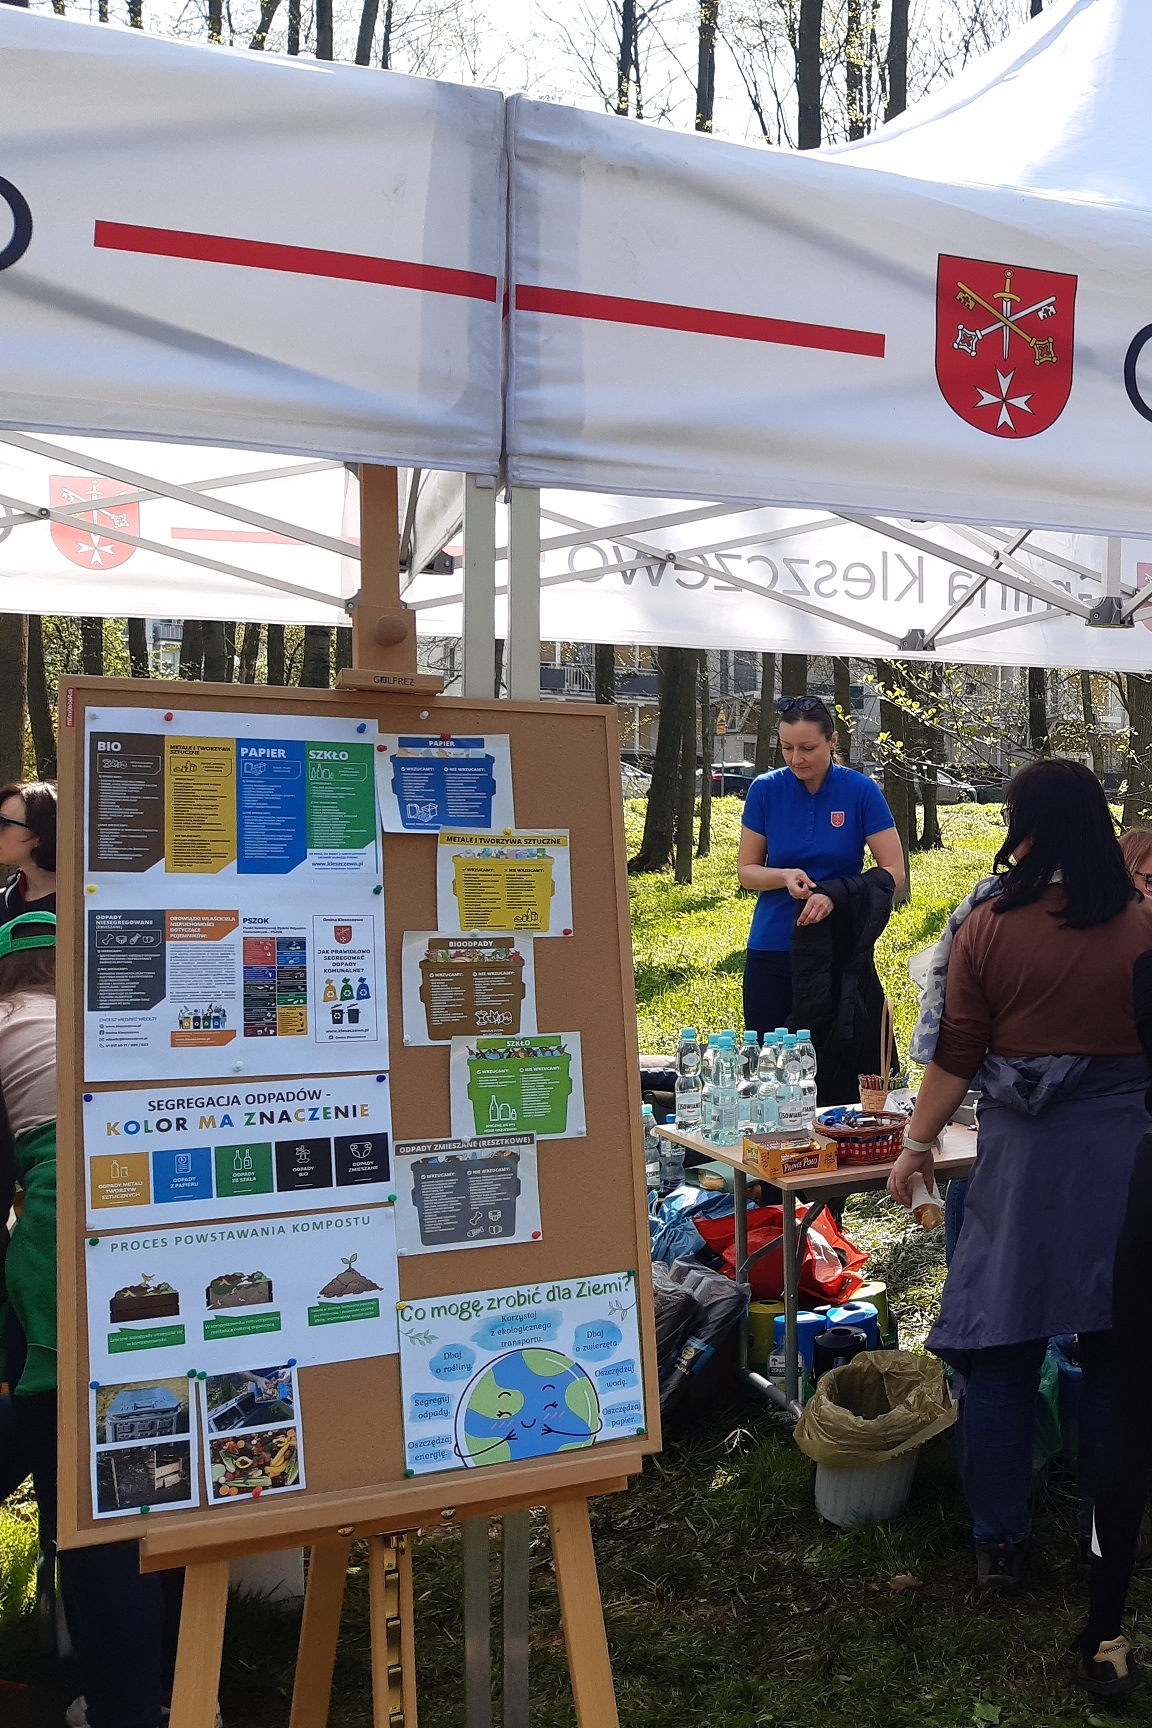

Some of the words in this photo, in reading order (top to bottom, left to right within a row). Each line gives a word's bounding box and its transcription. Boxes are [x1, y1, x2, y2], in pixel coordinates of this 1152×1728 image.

[98, 742, 121, 751] BIO
[241, 748, 286, 758] PAPIER
[309, 750, 348, 760] SZKŁO
[148, 1094, 241, 1112] SEGREGACJA
[245, 1088, 322, 1105] ODPADÓW
[106, 1117, 188, 1136] KOLOR
[198, 1114, 234, 1130] MA
[244, 1104, 369, 1126] ZNACZENIE
[400, 1145, 433, 1153] ODPADY
[434, 1142, 477, 1150] ZMIESZANE
[479, 1137, 530, 1147] (RESZTKOWE)
[111, 1237, 168, 1253] PROCES
[175, 1225, 286, 1246] POWSTAWANIA
[292, 1215, 371, 1234] KOMPOSTU
[401, 1304, 426, 1322] Co
[431, 1300, 484, 1321] mogę
[486, 1286, 543, 1311] zrobić
[546, 1285, 572, 1302] dla
[576, 1275, 631, 1297] Ziemi?
[501, 1311, 537, 1322] Korzystaj
[498, 1321, 552, 1336] ekologicznego
[587, 1329, 604, 1339] Dbaj
[582, 1339, 619, 1352] zwierzęta.
[443, 1351, 462, 1361] Dbaj
[444, 1361, 472, 1373] rośliny.
[595, 1363, 634, 1379] Oszczędzaj
[606, 1378, 628, 1388] wodę.
[414, 1395, 450, 1407] Segreguj
[418, 1407, 451, 1420] odpady.
[602, 1402, 641, 1417] Oszczędzaj
[611, 1415, 636, 1428] papier.
[408, 1435, 452, 1450] Oszczędzaj
[414, 1450, 448, 1462] energię.
